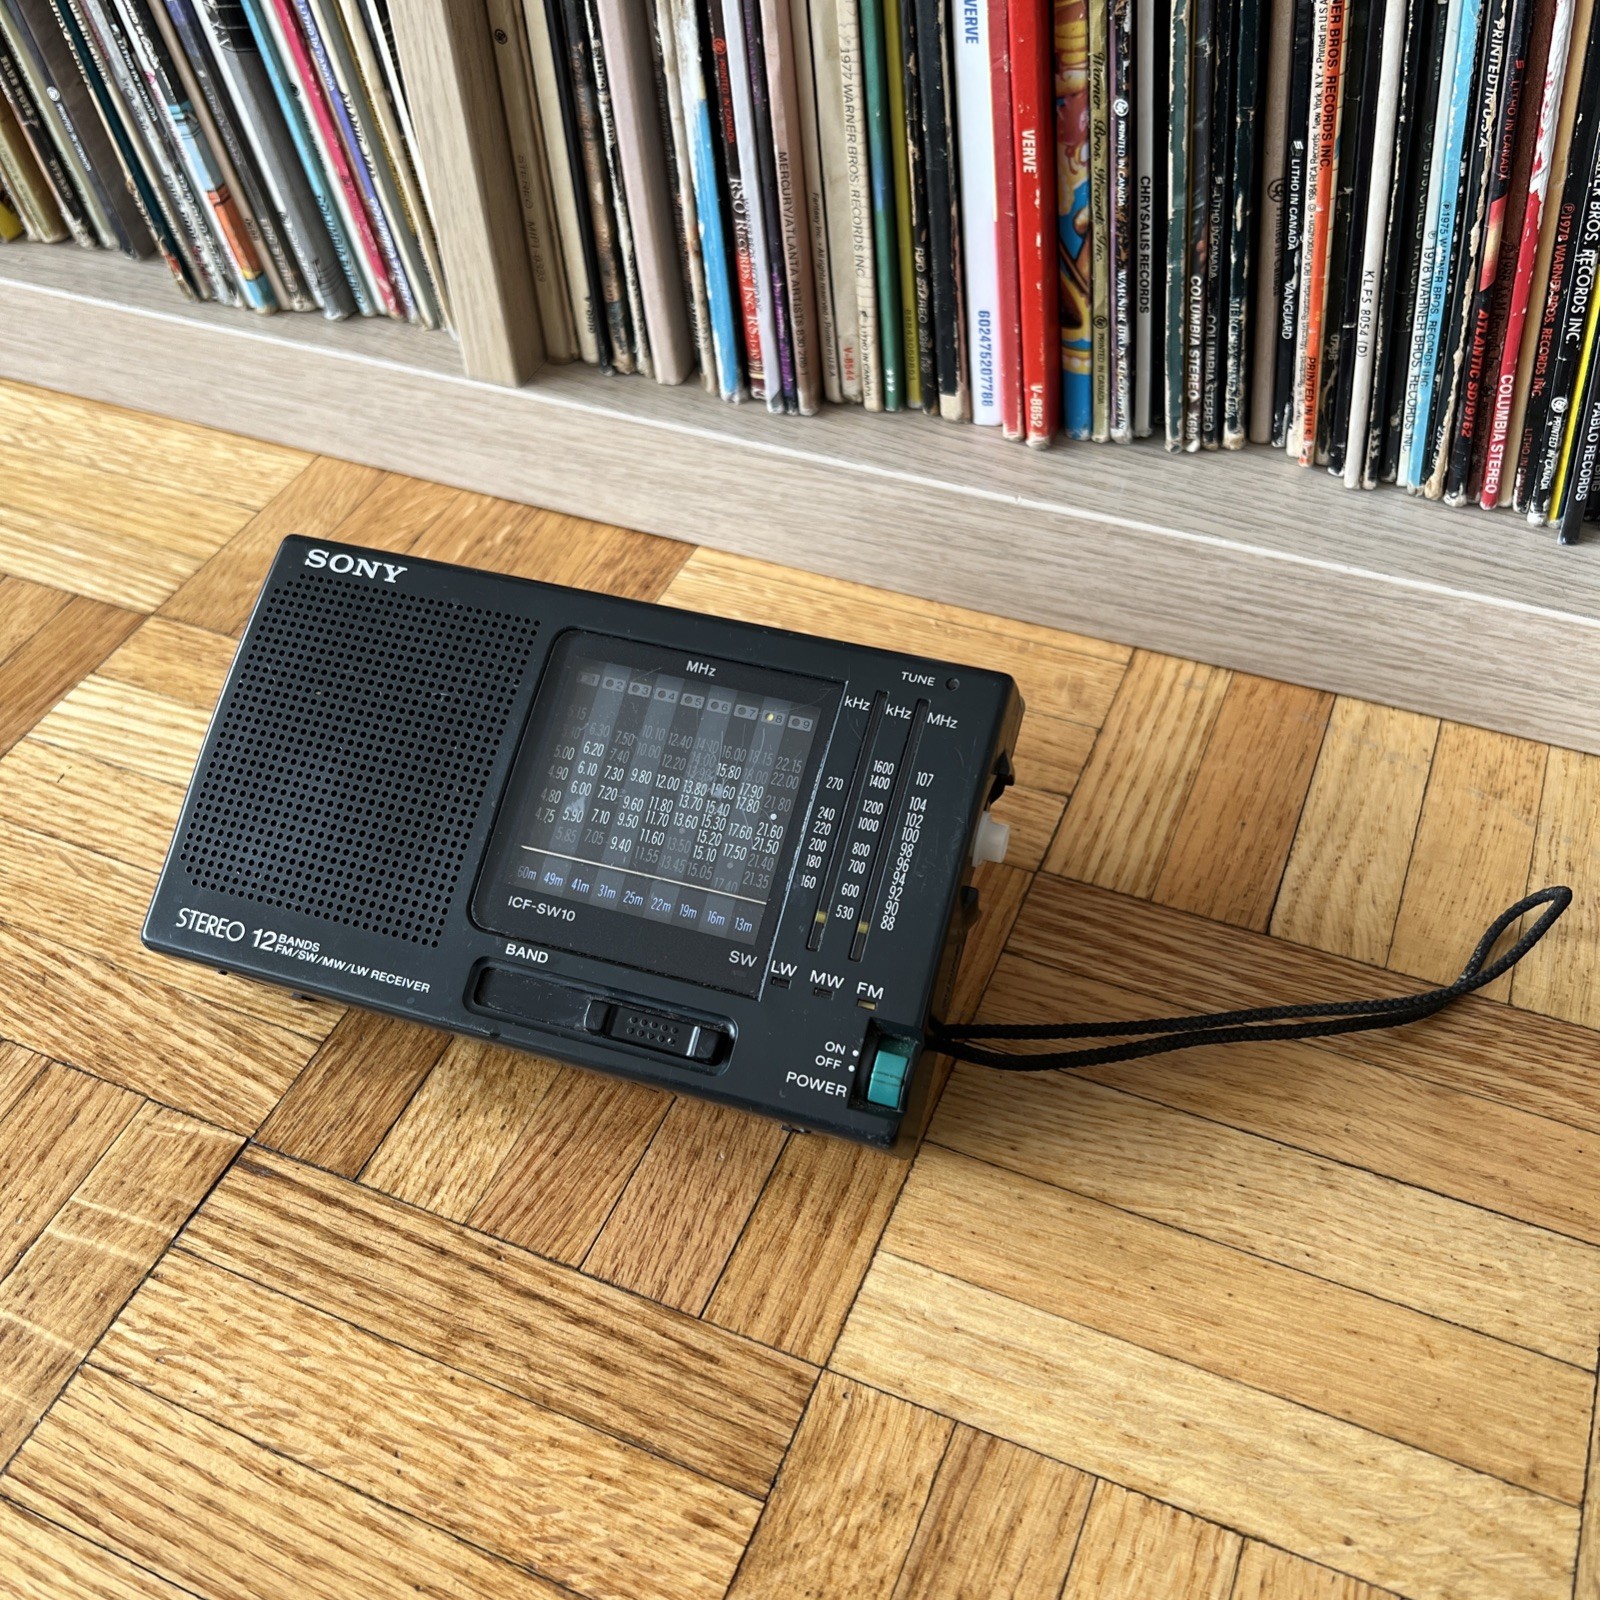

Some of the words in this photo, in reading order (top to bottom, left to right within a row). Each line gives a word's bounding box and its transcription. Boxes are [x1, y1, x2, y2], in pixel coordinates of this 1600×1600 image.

[964, 0, 979, 44] VERVE
[1327, 29, 1341, 71] BROS.
[1486, 20, 1504, 88] PRINTED
[1092, 52, 1106, 110] Warner
[718, 60, 730, 94] PRINTED
[724, 109, 735, 144] CANADA
[1484, 89, 1497, 104] IN
[1506, 80, 1520, 115] LITHO
[1321, 77, 1337, 142] RECORDS
[1478, 106, 1494, 152] U.S.A.
[1504, 119, 1514, 131] IN
[1118, 120, 1126, 157] PRINTED
[1022, 129, 1037, 174] VERVE
[1319, 144, 1333, 171] INC.
[1498, 134, 1513, 180] CANADA
[843, 83, 858, 144] WARNER
[851, 189, 865, 251] RECORDS
[1118, 160, 1125, 168] IN
[1290, 159, 1300, 192] LITHO
[729, 177, 748, 213] RSO
[1094, 167, 1107, 226] Records
[1117, 171, 1126, 206] CANADA
[1289, 194, 1299, 206] IN
[1139, 176, 1151, 250] CHRYSALIS
[1287, 208, 1299, 250] CANADA
[1422, 246, 1435, 273] 1978
[1139, 253, 1151, 314] RECORDS
[1571, 249, 1596, 314] RECORDS
[791, 279, 805, 325] ARTISTS
[1189, 276, 1202, 346] COLUMBIA
[1281, 281, 1297, 340] VANGUARD
[1416, 278, 1432, 331] WARNER
[1359, 308, 1372, 336] 8054
[1565, 318, 1583, 344] INC.
[1356, 341, 1368, 359] (D)
[1424, 320, 1437, 367] RECORDS
[1469, 309, 1488, 379] ATLANTIC
[1536, 328, 1553, 375] RECORDS
[1187, 350, 1200, 400] STEREO
[1304, 357, 1316, 403] PRINTED
[1203, 384, 1215, 432] STEREO
[1404, 375, 1420, 430] RECORDS
[1489, 374, 1514, 445] COLUMBIA
[1549, 415, 1562, 447] PRINTED
[1484, 444, 1505, 494] STEREO
[1540, 459, 1554, 490] CANADA
[1575, 445, 1597, 502] RECORDS
[304, 548, 408, 584] SONY
[686, 660, 717, 677] MHz
[901, 671, 936, 687] TUNE
[844, 695, 871, 712] kHz
[885, 703, 912, 720] kHz
[927, 712, 959, 729] MHz
[583, 741, 605, 757] 6.20
[578, 760, 598, 777] 6.10
[604, 765, 624, 782] 7.30
[630, 768, 652, 784] 9.80
[716, 762, 742, 780] 15.80
[873, 759, 895, 776] 1600
[570, 780, 592, 797] 6.00
[655, 774, 680, 791] 12.00
[682, 779, 708, 797] 13.80
[825, 776, 844, 791] 270
[869, 774, 890, 790] 1400
[915, 771, 935, 788] 107
[597, 784, 618, 801] 7.20
[739, 782, 764, 800] 17.90
[622, 795, 644, 812] 9.60
[649, 796, 674, 814] 11.80
[678, 794, 703, 811] 13.70
[705, 799, 731, 818] 15.40
[735, 796, 760, 814] 17.80
[862, 799, 884, 815] 1200
[909, 796, 928, 813] 104
[562, 806, 584, 823] 5.90
[591, 808, 610, 825] 7.10
[617, 812, 639, 829] 9.50
[645, 810, 670, 828] 11.70
[673, 811, 699, 830] 13.60
[701, 813, 727, 832] 15.30
[817, 806, 836, 821] 240
[905, 812, 924, 829] 102
[728, 822, 753, 841] 17.60
[756, 822, 784, 840] 21.60
[813, 821, 832, 836] 220
[857, 817, 880, 833] 1000
[640, 828, 665, 846] 11.60
[696, 828, 722, 847] 15.20
[901, 826, 920, 844] 100
[610, 836, 632, 853] 9.40
[722, 843, 748, 861] 17.50
[751, 837, 779, 855] 21.50
[808, 838, 827, 853] 200
[851, 842, 871, 858] 800
[899, 842, 915, 858] 98
[692, 845, 717, 863] 15.10
[806, 854, 822, 869] 180
[848, 859, 866, 875] 700
[895, 857, 911, 873] 96
[800, 874, 817, 890] 160
[892, 872, 907, 887] 94
[841, 882, 860, 898] 600
[888, 886, 903, 901] 92
[507, 895, 576, 922] ICF-SW10
[544, 872, 563, 887] 49m
[571, 878, 590, 894] 41m
[597, 884, 617, 899] 31m
[622, 890, 644, 906] 25m
[651, 897, 671, 913] 22m
[679, 903, 698, 919] 19m
[707, 910, 726, 926] 16m
[734, 917, 753, 933] 13m
[884, 900, 899, 916] 90
[835, 904, 854, 921] 530
[175, 907, 245, 942] STEREO
[251, 928, 277, 952] 12
[880, 916, 895, 931] 88
[277, 933, 321, 953] BANDS
[505, 943, 549, 964] BAND
[729, 950, 758, 968] SW
[274, 944, 369, 977] FM/SW/MW/LW
[370, 969, 431, 993] RECEIVER
[771, 960, 798, 977] LW
[809, 969, 845, 989] MW
[856, 982, 884, 1000] FM
[824, 1041, 846, 1055] ON
[815, 1055, 842, 1069] OFF
[786, 1071, 848, 1098] POWER
